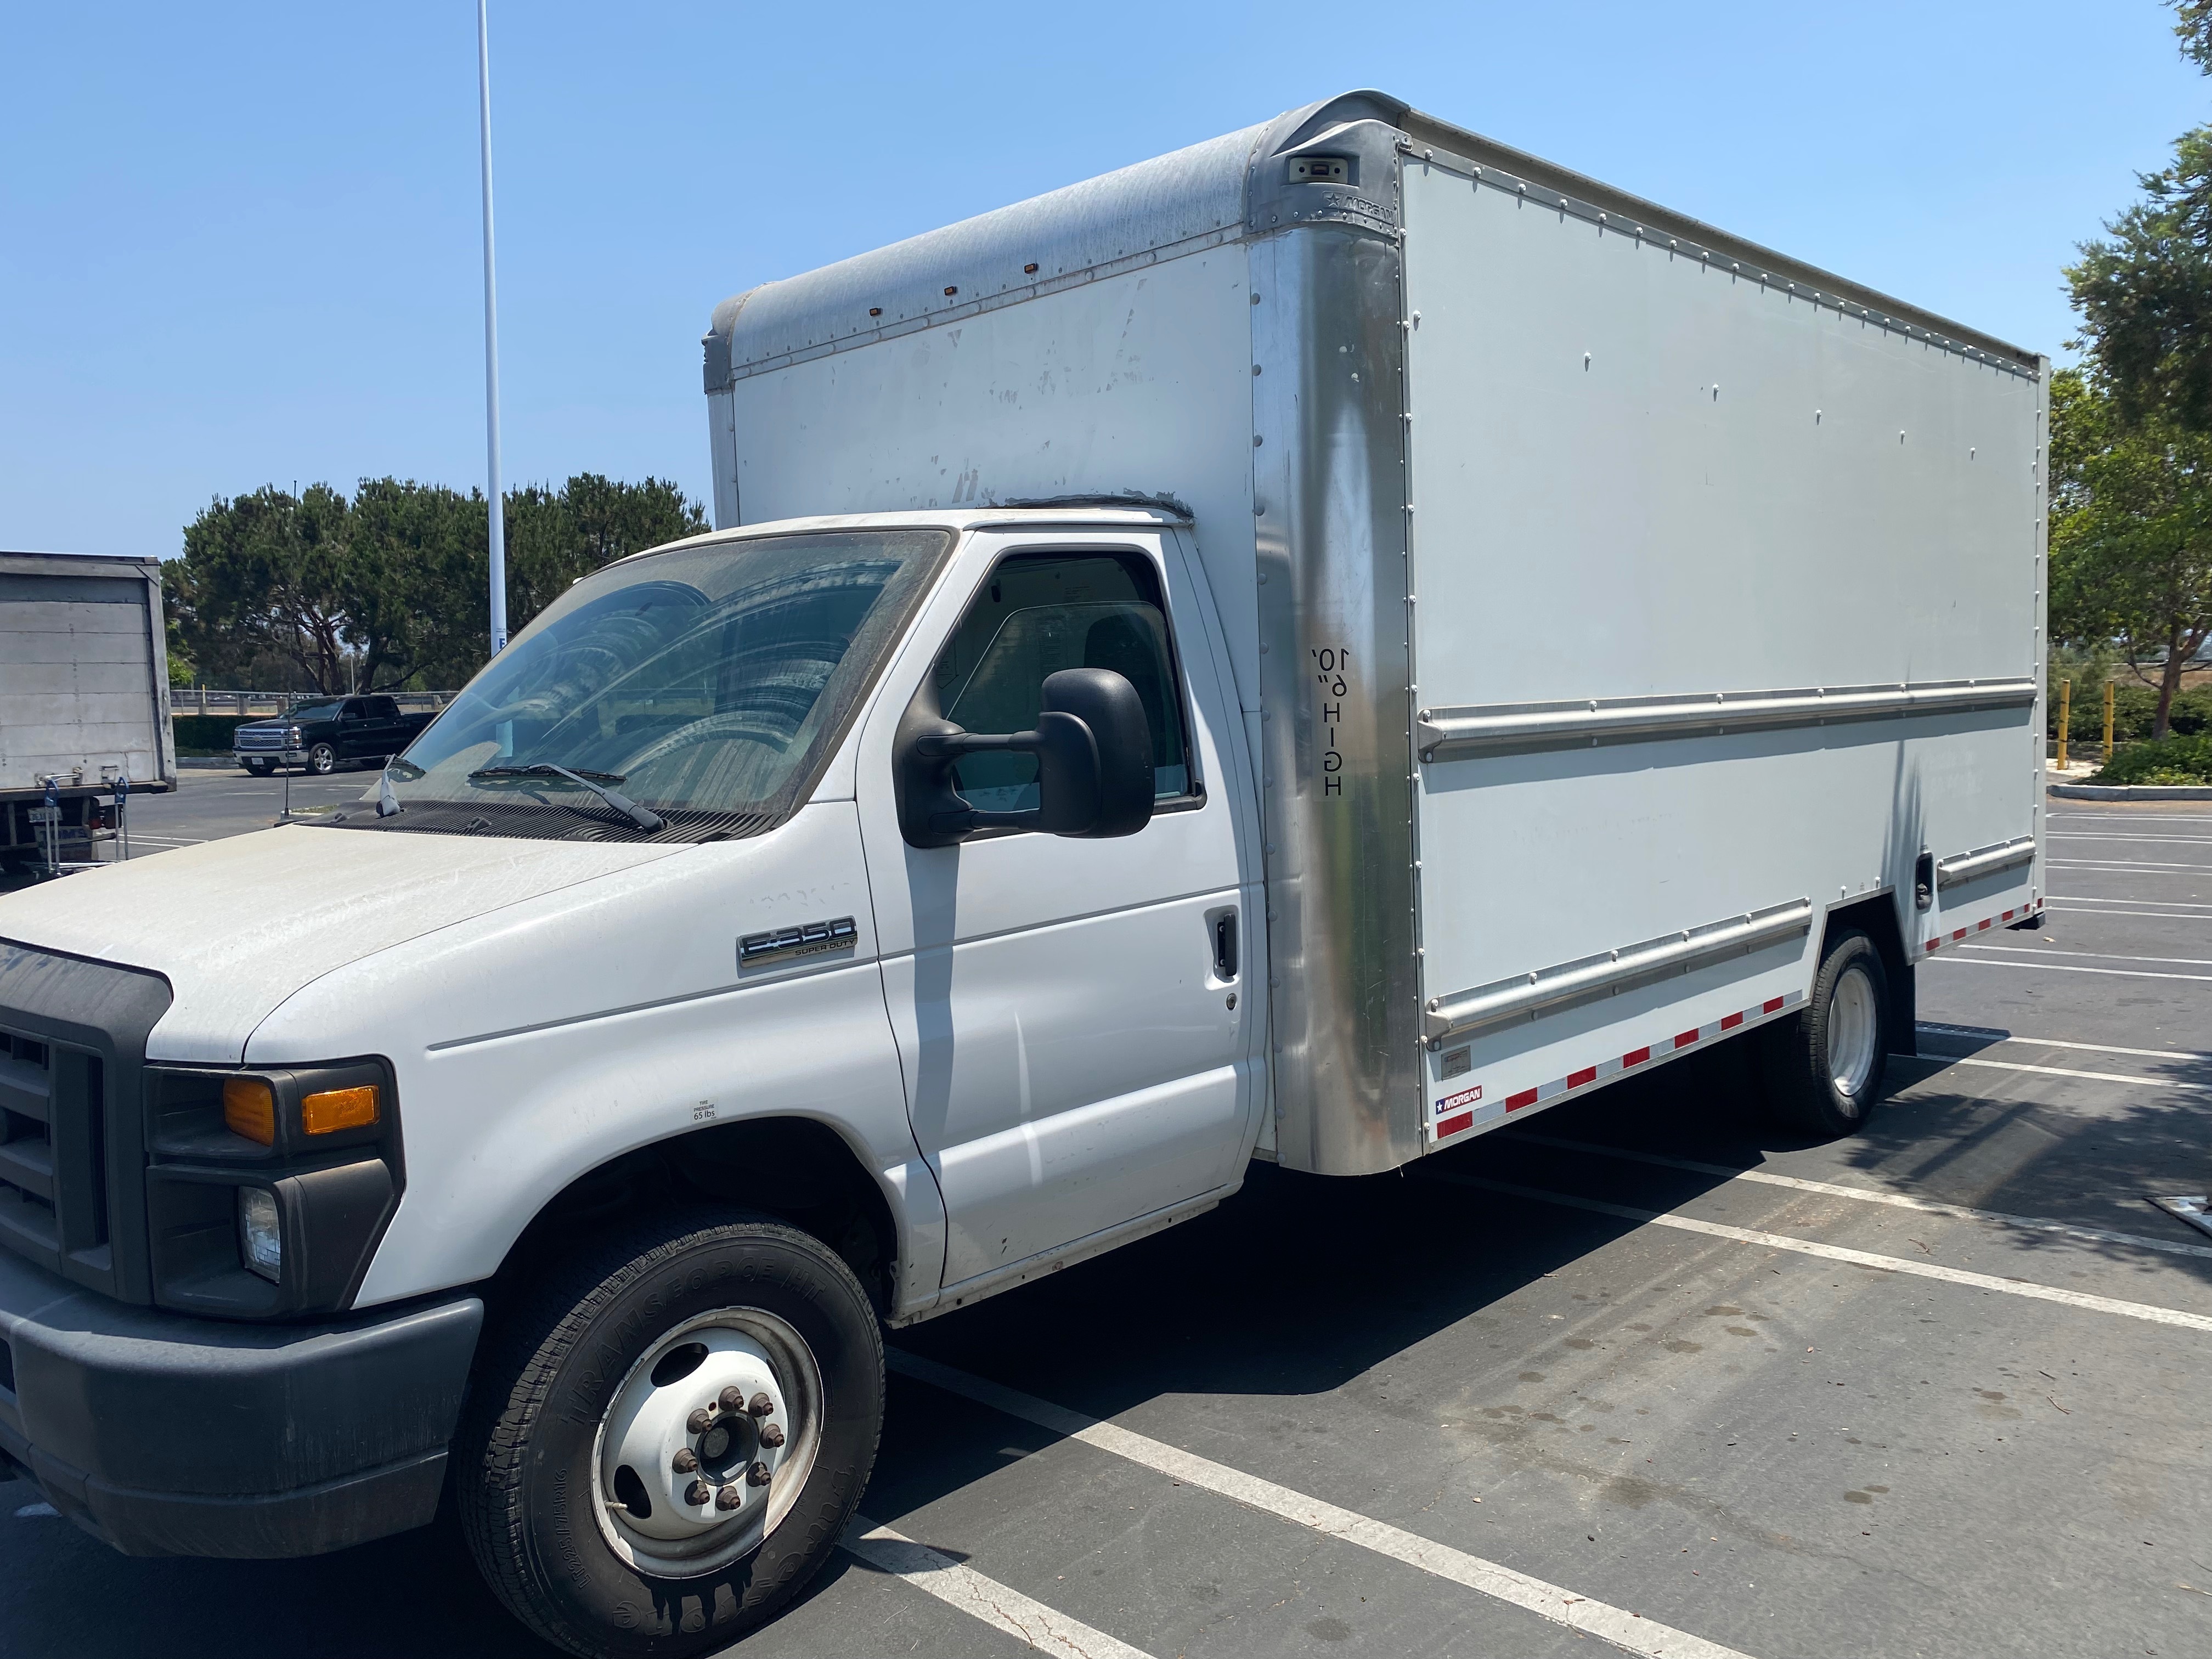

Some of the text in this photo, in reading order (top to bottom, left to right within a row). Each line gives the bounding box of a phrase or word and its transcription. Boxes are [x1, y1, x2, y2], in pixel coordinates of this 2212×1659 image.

[742, 917, 855, 955] E-350
[795, 939, 854, 955] SUPER DUTY
[693, 1104, 714, 1112] PRESSURE
[1444, 1088, 1481, 1110] MORGAN
[559, 1256, 828, 1426] TRANSFORCE HT
[553, 1468, 592, 1589] LT225/75R16
